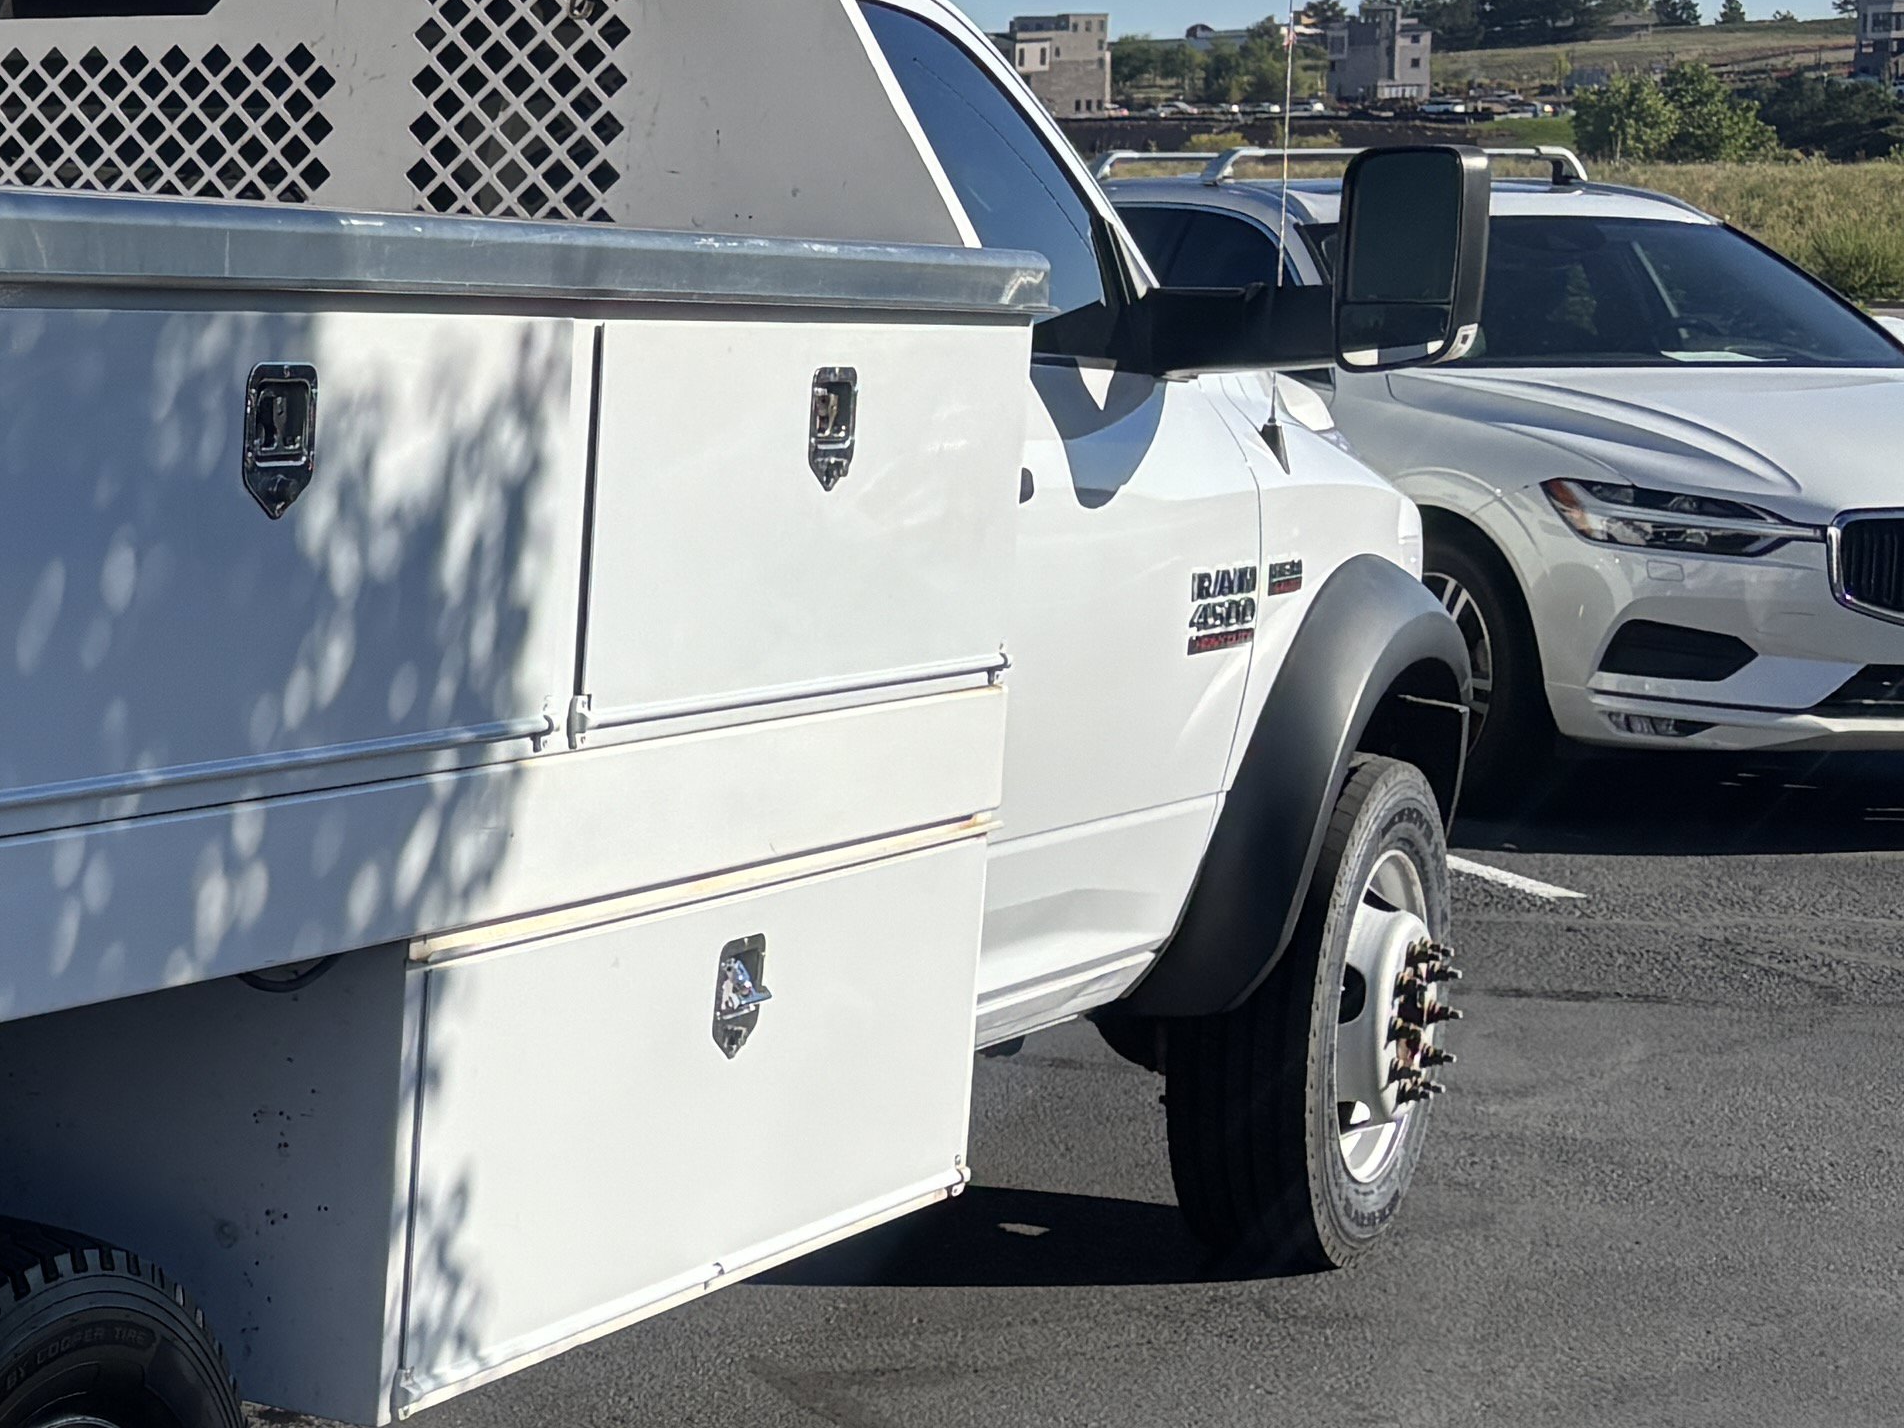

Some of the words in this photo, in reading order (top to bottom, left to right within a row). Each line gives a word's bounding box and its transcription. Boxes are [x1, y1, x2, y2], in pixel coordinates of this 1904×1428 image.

[1191, 565, 1257, 602] RAM
[6, 1360, 29, 1391] BY
[36, 1327, 106, 1365] COOPER
[114, 1325, 149, 1346] TIRE
